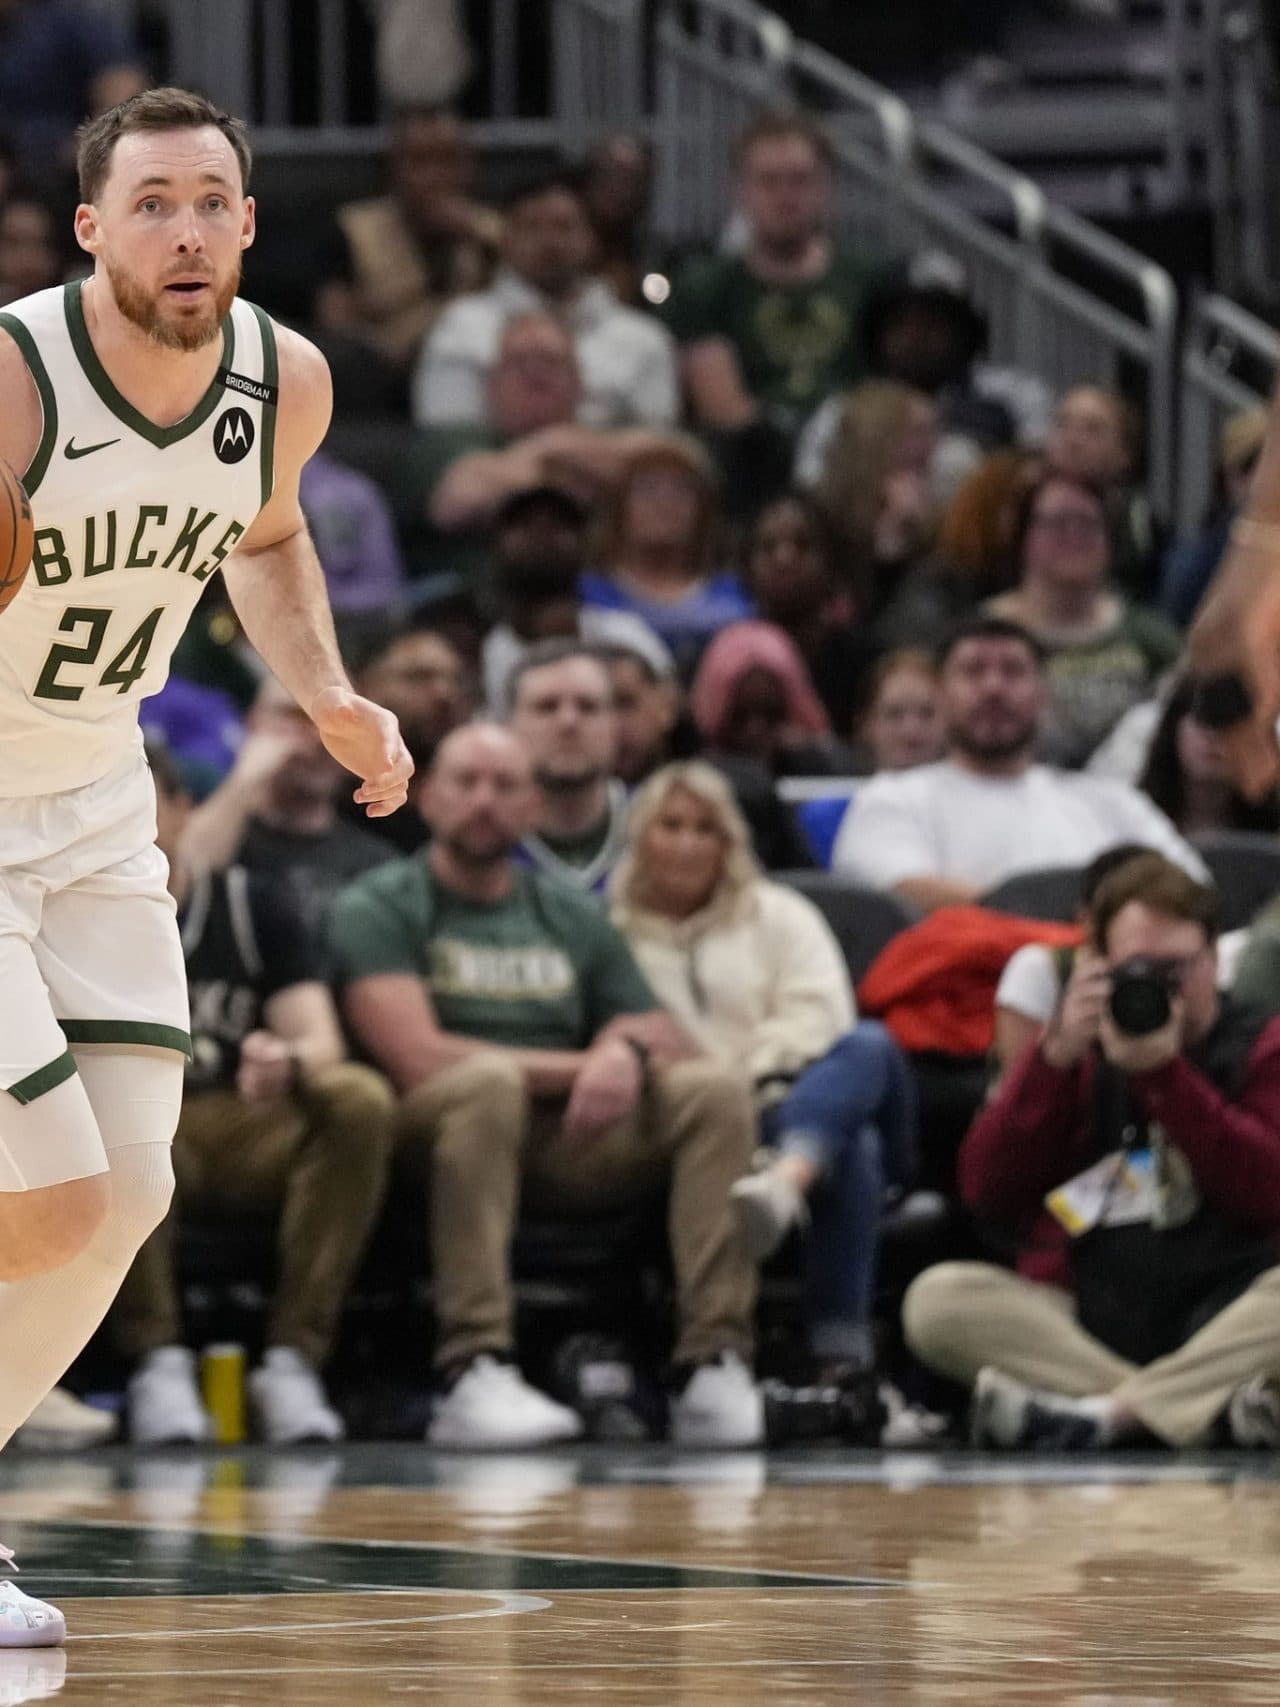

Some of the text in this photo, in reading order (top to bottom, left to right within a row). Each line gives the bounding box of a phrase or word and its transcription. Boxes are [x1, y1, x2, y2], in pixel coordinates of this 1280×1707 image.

[225, 374, 270, 400] BRIDGEMAN
[33, 505, 245, 586] BUCKS
[32, 606, 166, 701] 24
